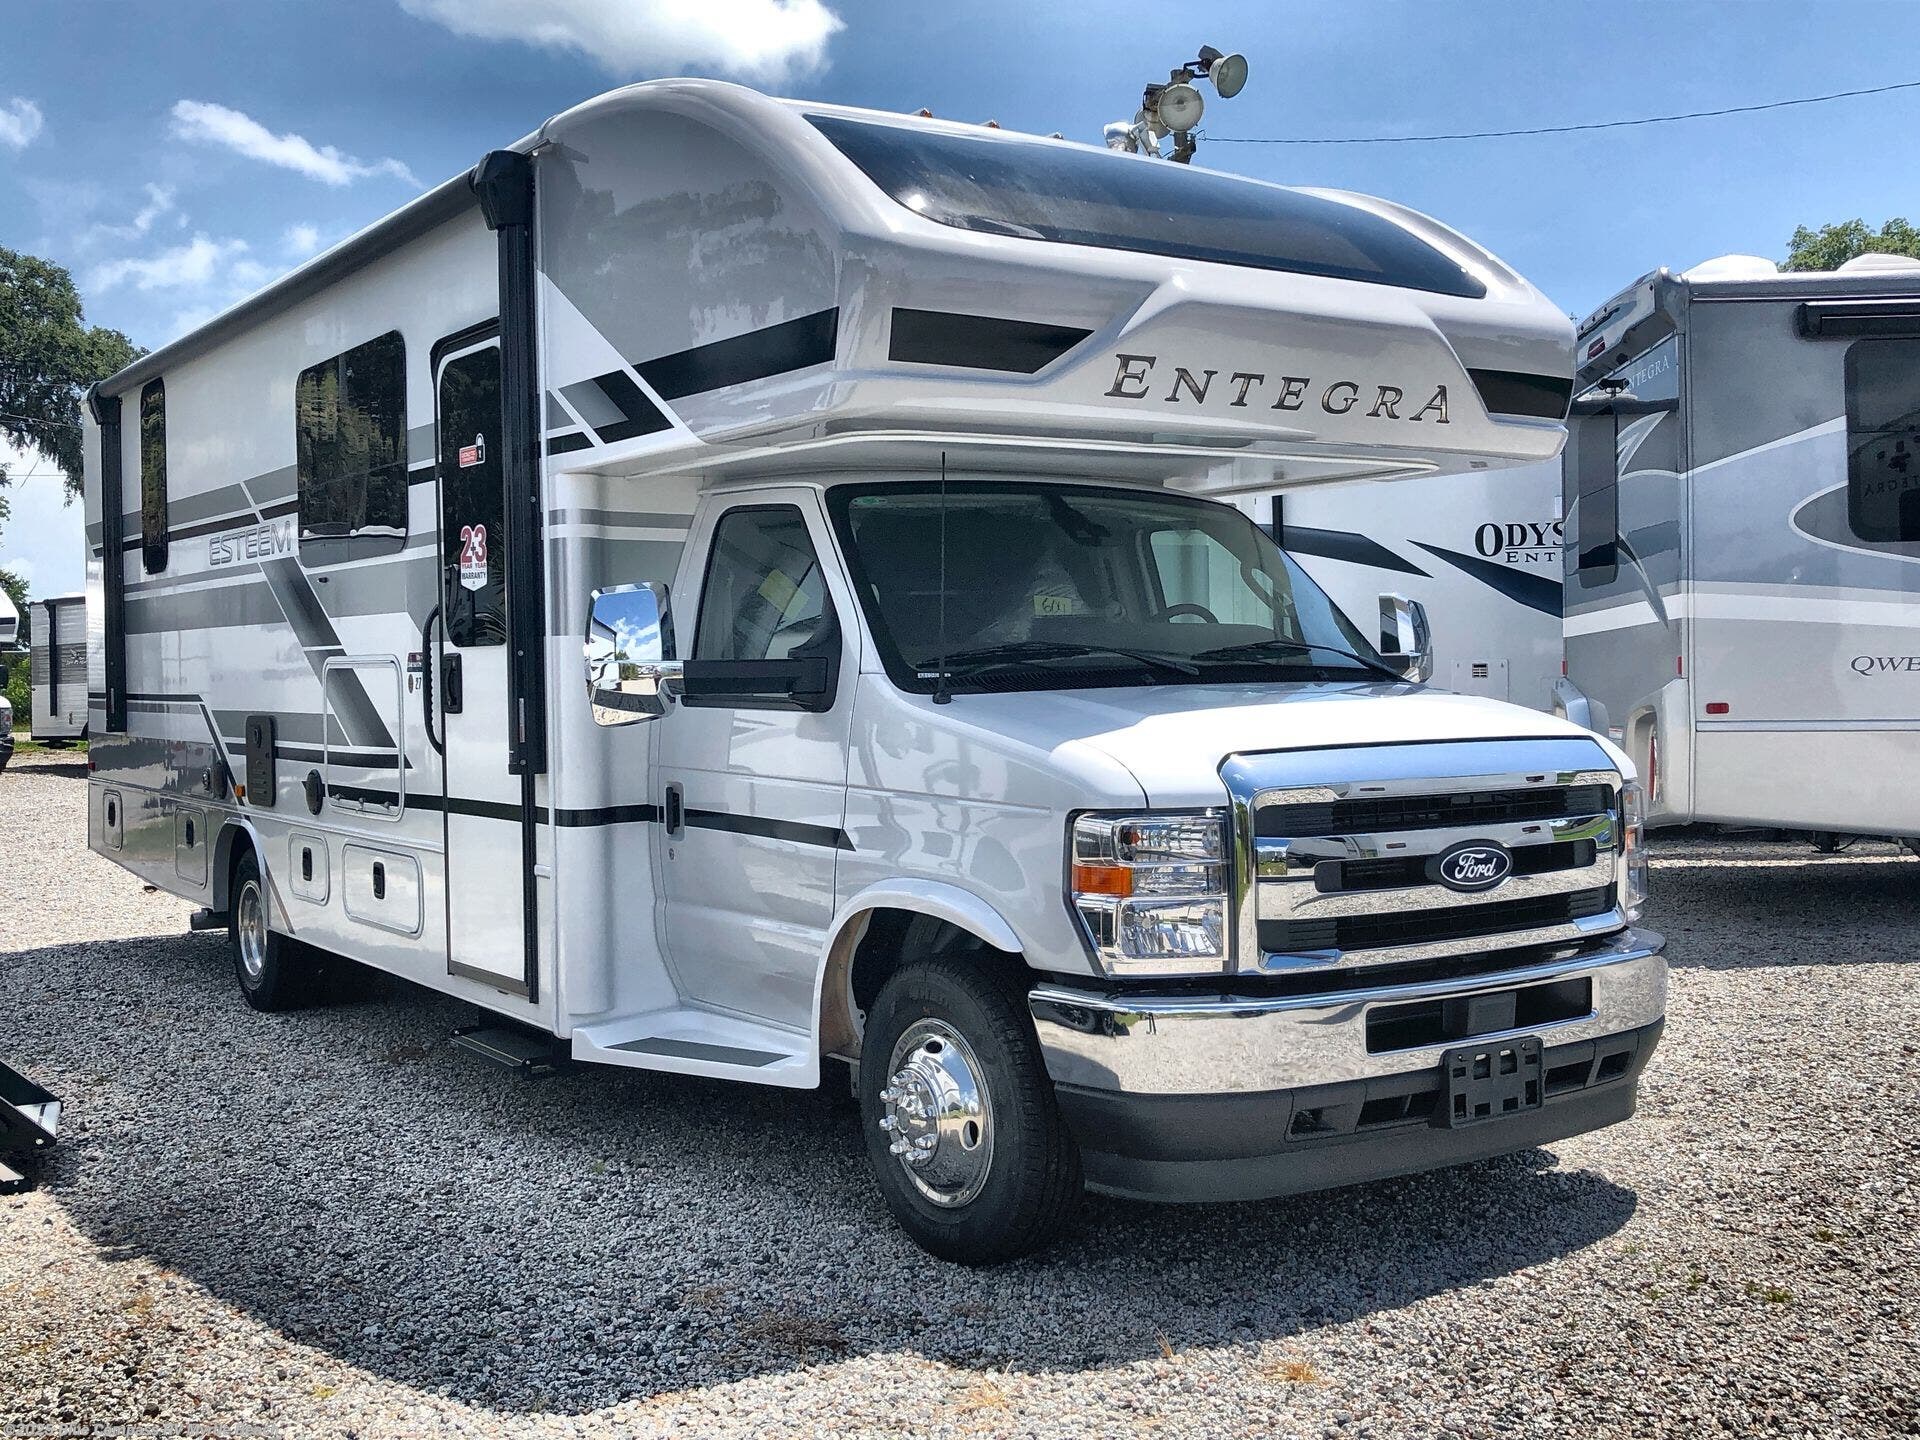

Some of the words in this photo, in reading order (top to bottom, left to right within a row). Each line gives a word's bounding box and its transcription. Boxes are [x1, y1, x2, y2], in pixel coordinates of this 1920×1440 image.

[1104, 353, 1451, 424] ENTEGRA
[1627, 355, 1670, 391] NTEGRA
[209, 520, 292, 566] ESTEEM
[1455, 853, 1497, 880] Ford
